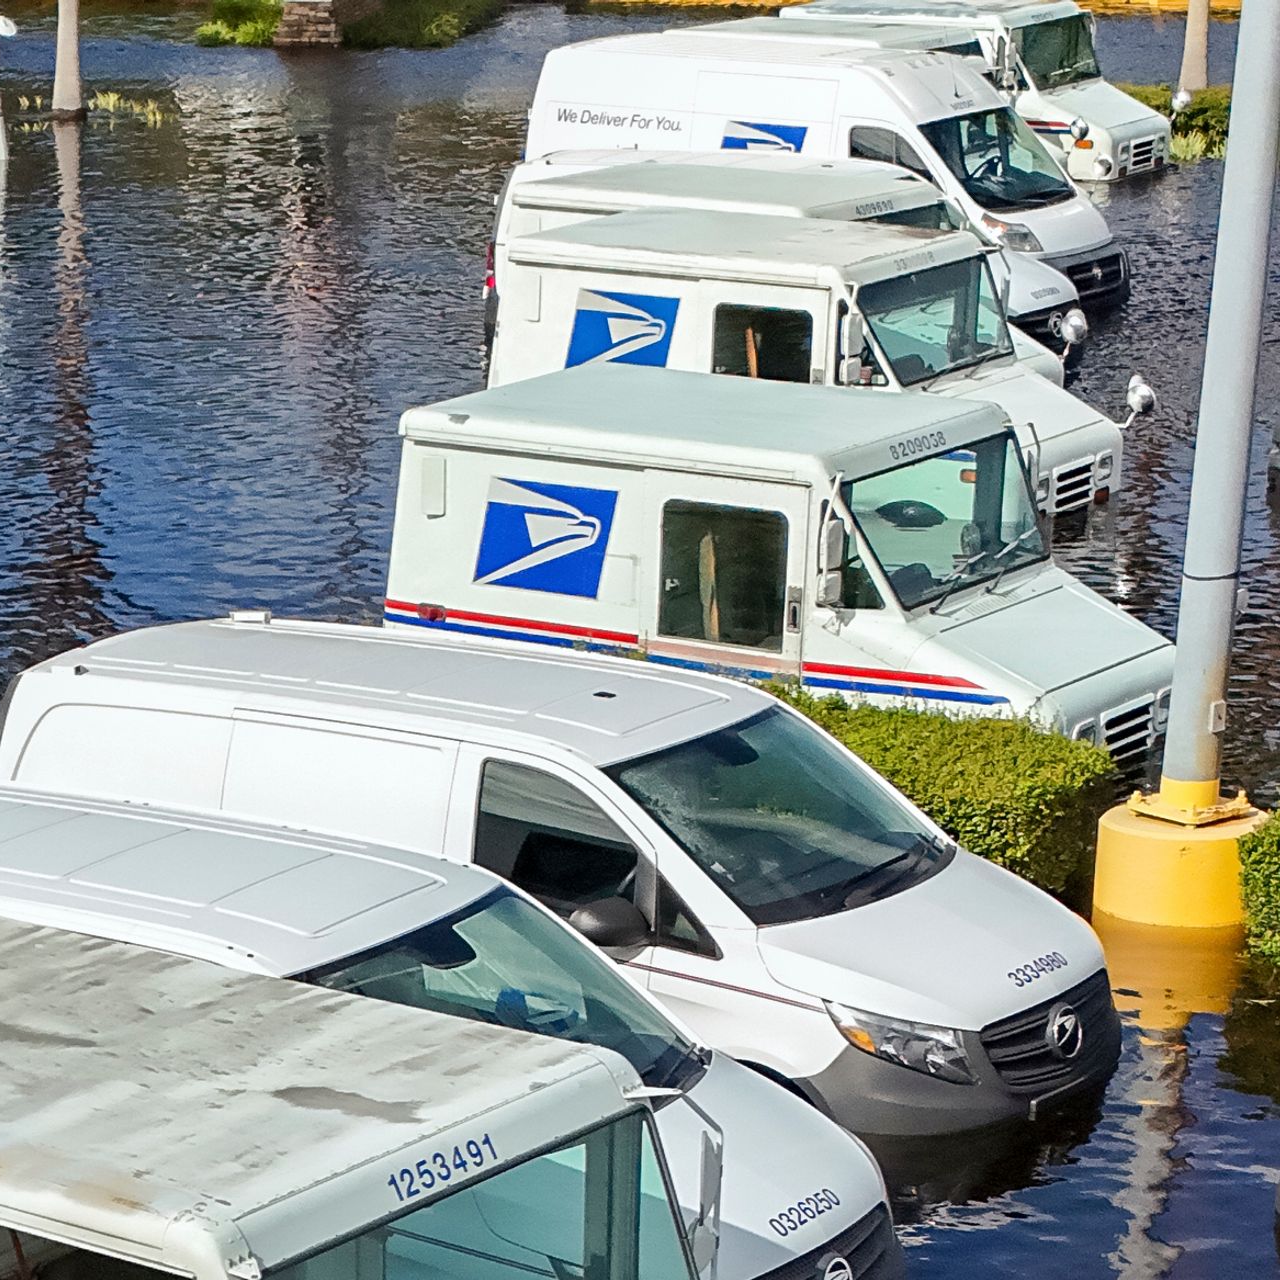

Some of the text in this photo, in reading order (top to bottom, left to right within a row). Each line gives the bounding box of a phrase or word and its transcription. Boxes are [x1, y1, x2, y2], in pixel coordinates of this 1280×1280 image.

[556, 107, 683, 131] We Deliver For You.
[1007, 951, 1069, 988] 3334980
[386, 1133, 498, 1202] 1253491
[768, 1188, 841, 1237] 0326250
